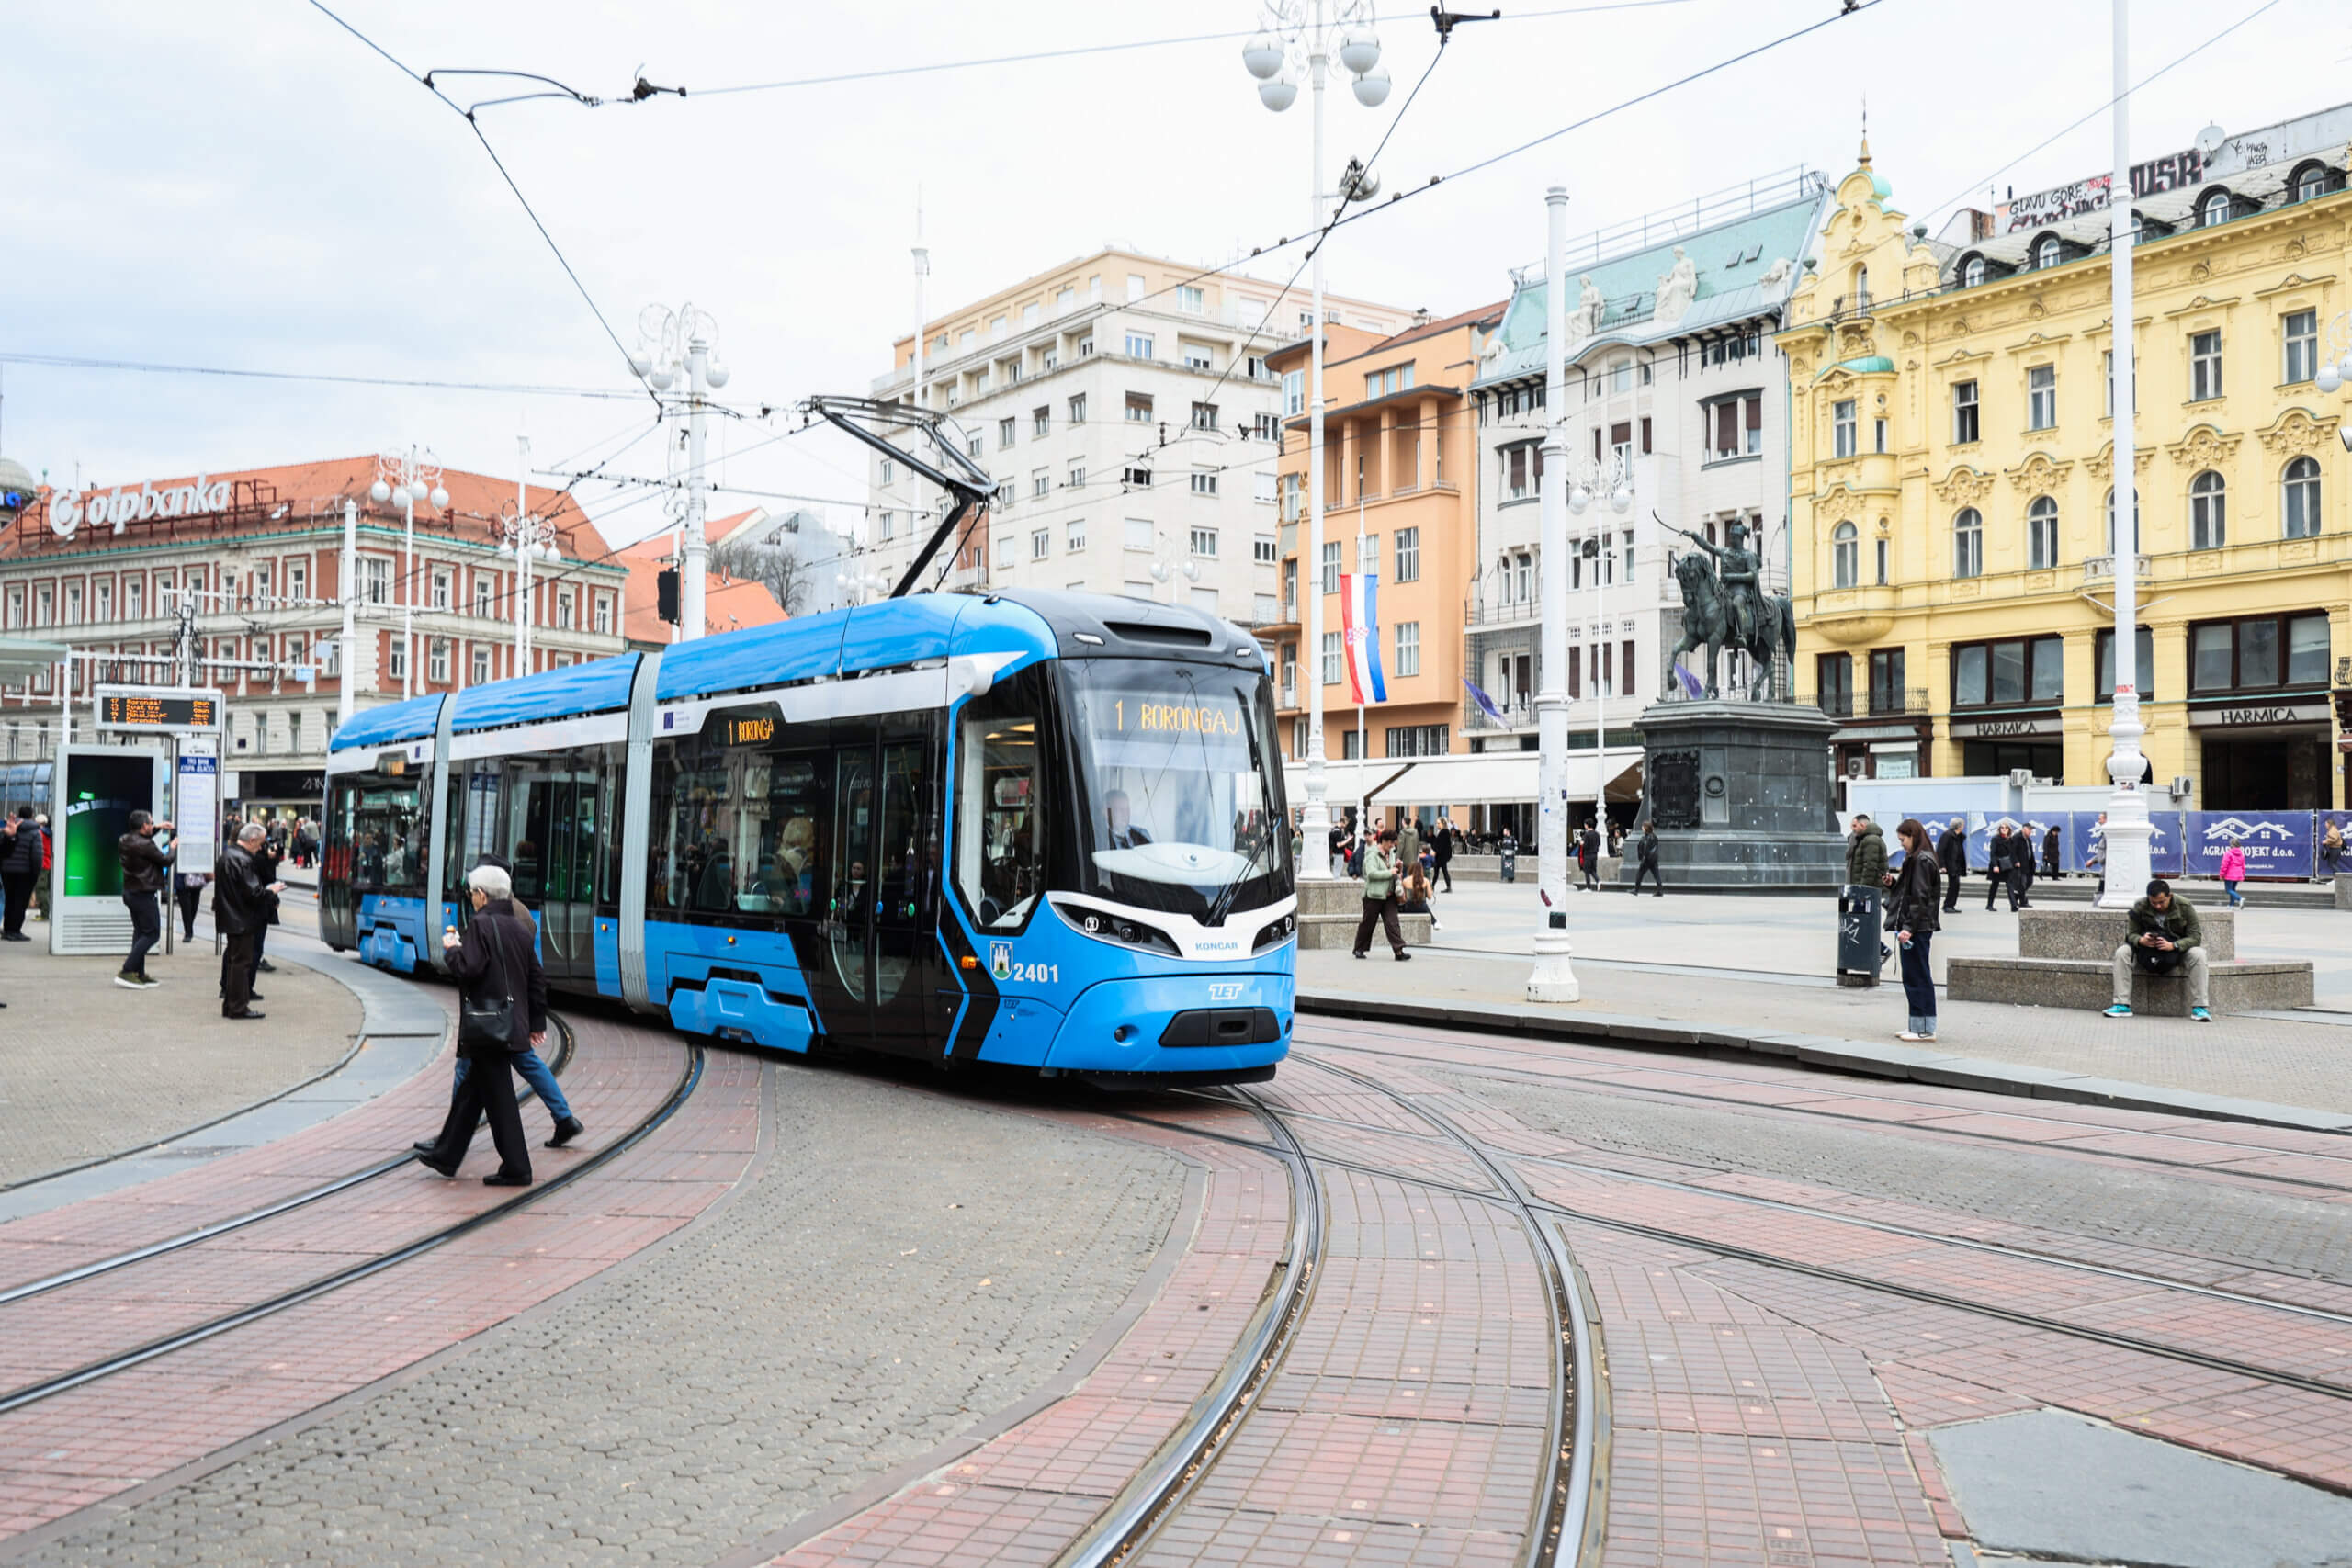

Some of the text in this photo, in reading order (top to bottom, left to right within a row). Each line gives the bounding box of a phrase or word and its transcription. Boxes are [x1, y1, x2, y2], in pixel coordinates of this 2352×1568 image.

[88, 473, 231, 535] otpbanka
[1115, 698, 1239, 735] 1 BORONGAJ
[2221, 707, 2297, 724] HARMICA
[728, 719, 733, 747] 1
[1976, 720, 2037, 736] HARMICA
[2272, 845, 2295, 857] d.o.o.
[1013, 963, 1058, 983] 2401
[1208, 983, 1244, 1000] ZET
